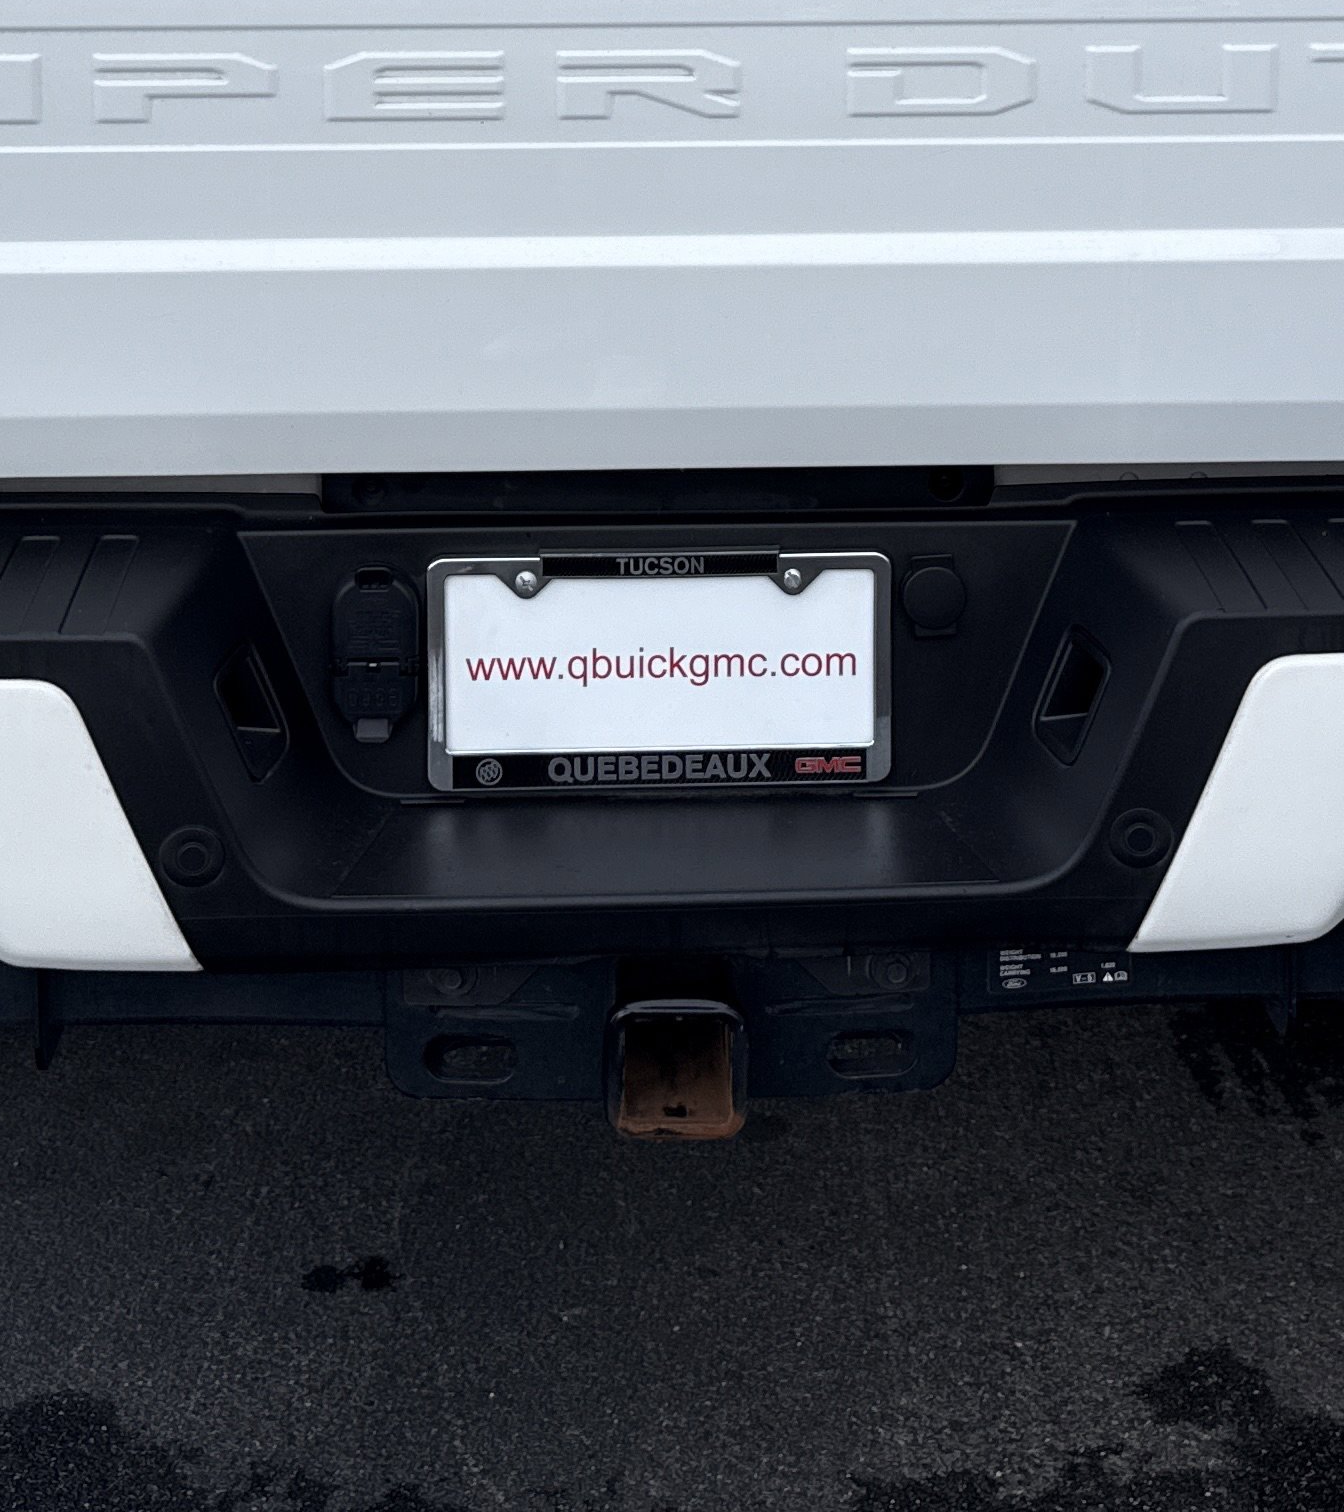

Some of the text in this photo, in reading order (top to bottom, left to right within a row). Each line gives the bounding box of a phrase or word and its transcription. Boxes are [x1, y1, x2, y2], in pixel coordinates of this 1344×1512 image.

[614, 556, 706, 576] TUCSON
[465, 646, 857, 687] www.qbuickgmc.com
[547, 752, 862, 784] QUEBEDEAUX GMC
